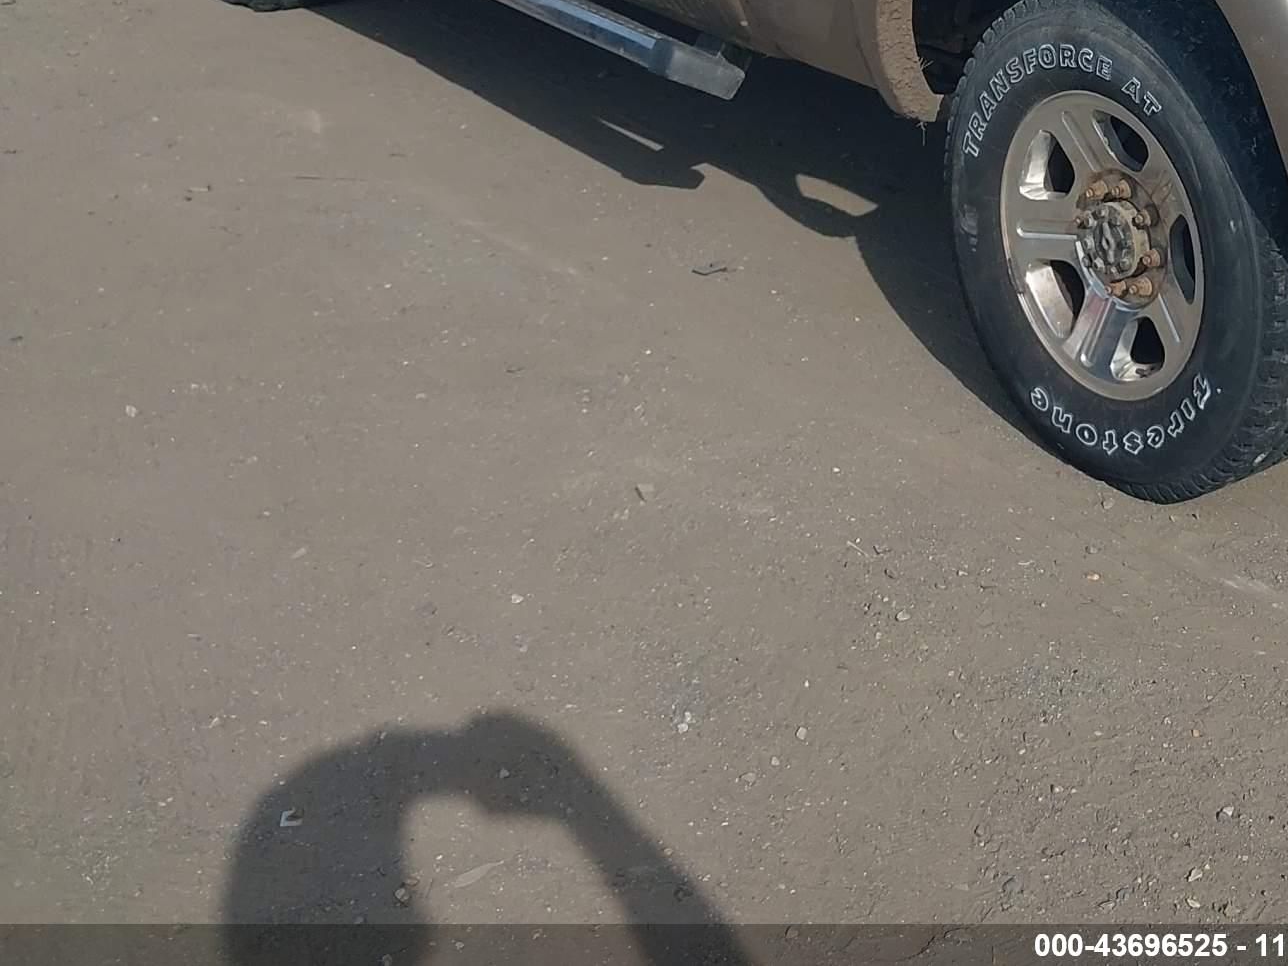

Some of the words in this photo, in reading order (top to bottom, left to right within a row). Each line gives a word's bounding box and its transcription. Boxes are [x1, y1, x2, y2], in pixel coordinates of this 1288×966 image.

[962, 43, 1114, 158] TRANSFORCE
[1121, 76, 1163, 117] AT
[1030, 373, 1211, 456] Firestone
